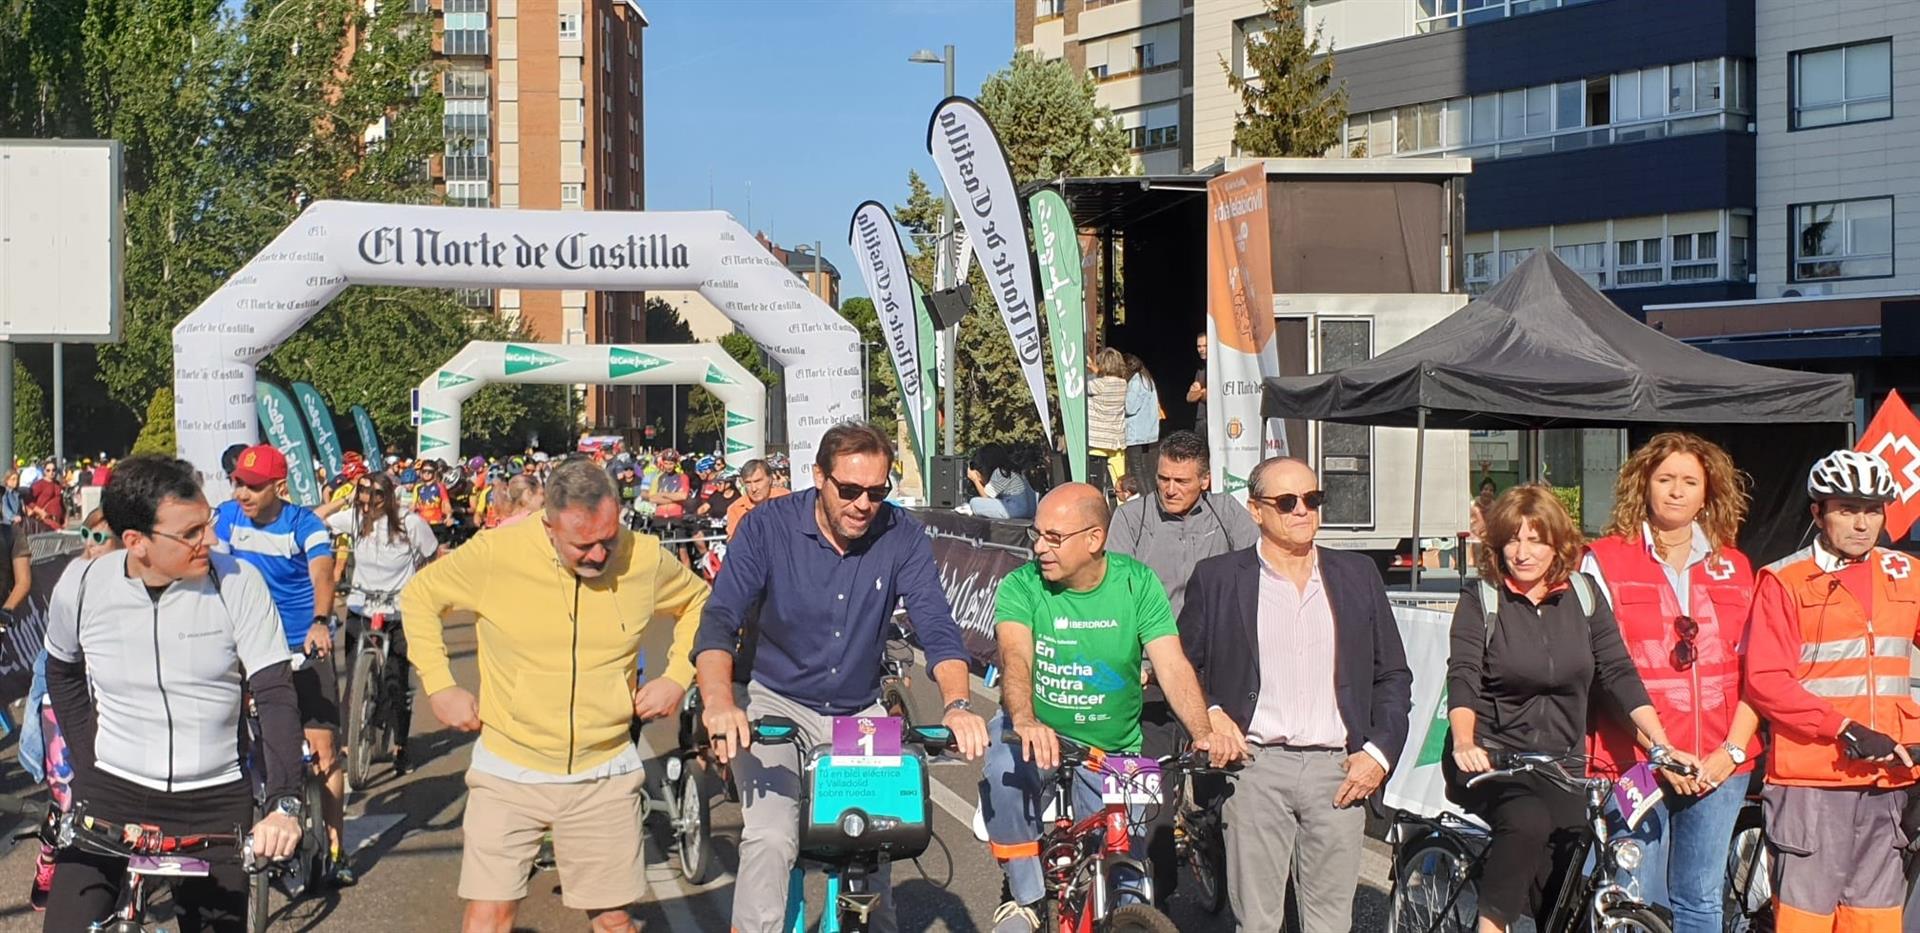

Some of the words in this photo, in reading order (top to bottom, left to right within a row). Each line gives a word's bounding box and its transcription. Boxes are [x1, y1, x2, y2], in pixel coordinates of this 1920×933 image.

[358, 226, 405, 266] El
[411, 227, 506, 268] Norte
[513, 233, 548, 270] de
[555, 231, 691, 271] Castilla
[1069, 619, 1118, 629] IBERDROLA
[1035, 640, 1055, 659] En
[1048, 690, 1106, 705] cáncer
[857, 734, 874, 756] 1
[844, 769, 861, 778] bici
[863, 768, 901, 778] eléctrica
[826, 779, 868, 788] Valladolid
[818, 789, 844, 798] sobre
[845, 789, 876, 798] ruedas
[1626, 786, 1644, 809] 3
